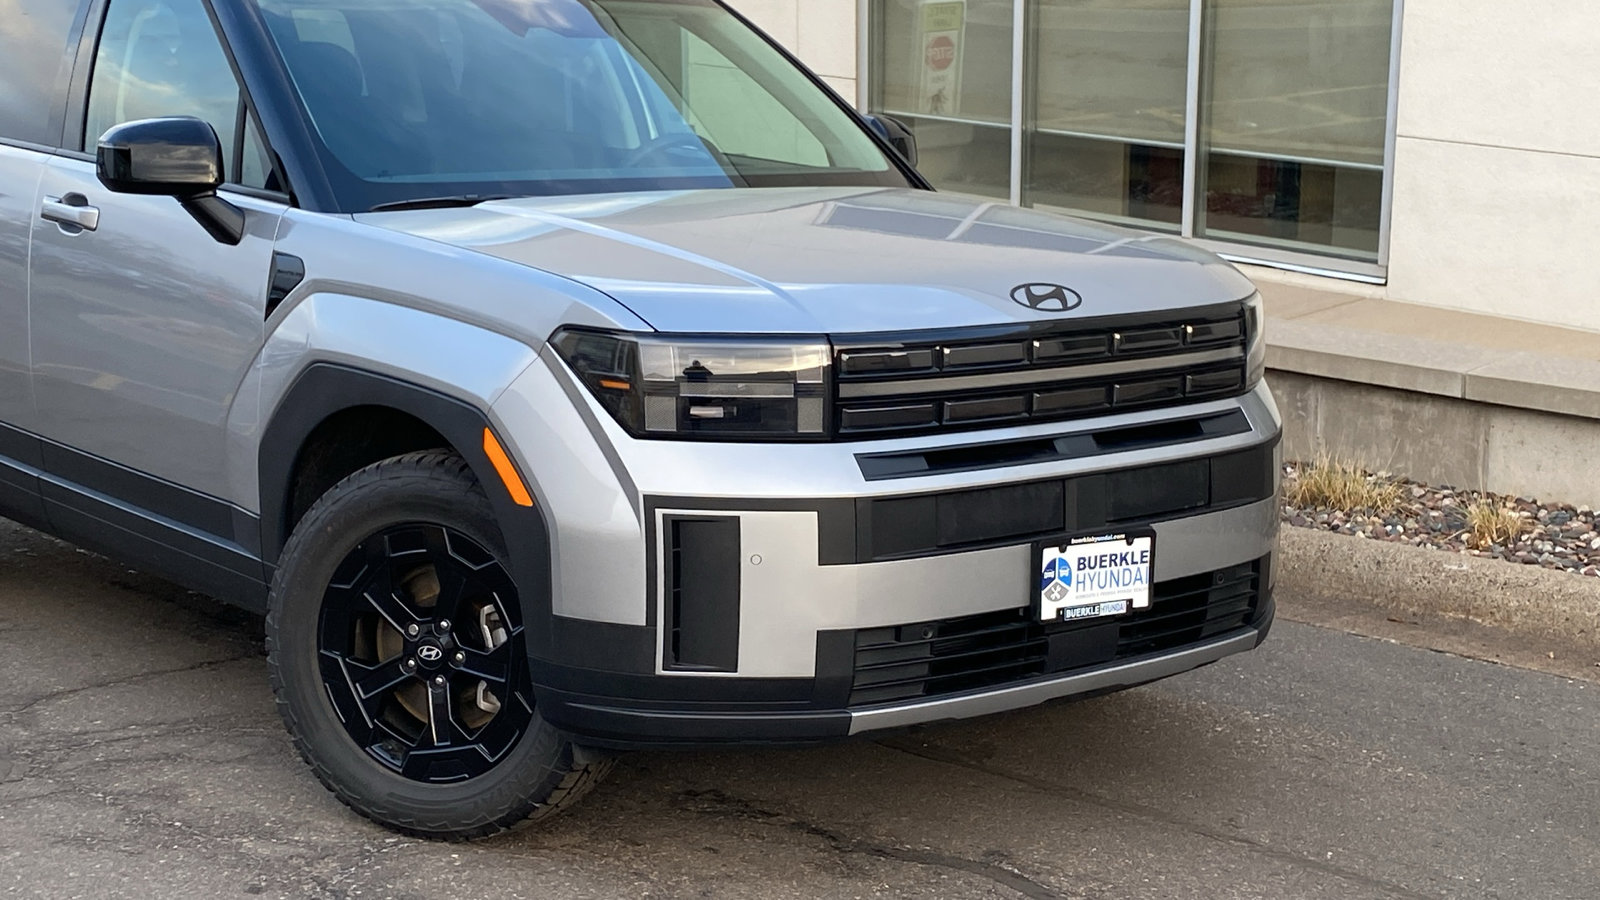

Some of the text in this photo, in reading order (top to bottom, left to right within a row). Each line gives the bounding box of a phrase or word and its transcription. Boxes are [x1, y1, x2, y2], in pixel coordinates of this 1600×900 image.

[1077, 550, 1149, 571] BUERKLE
[1075, 566, 1149, 592] HYUNDAI
[1065, 605, 1100, 618] BUERKLE
